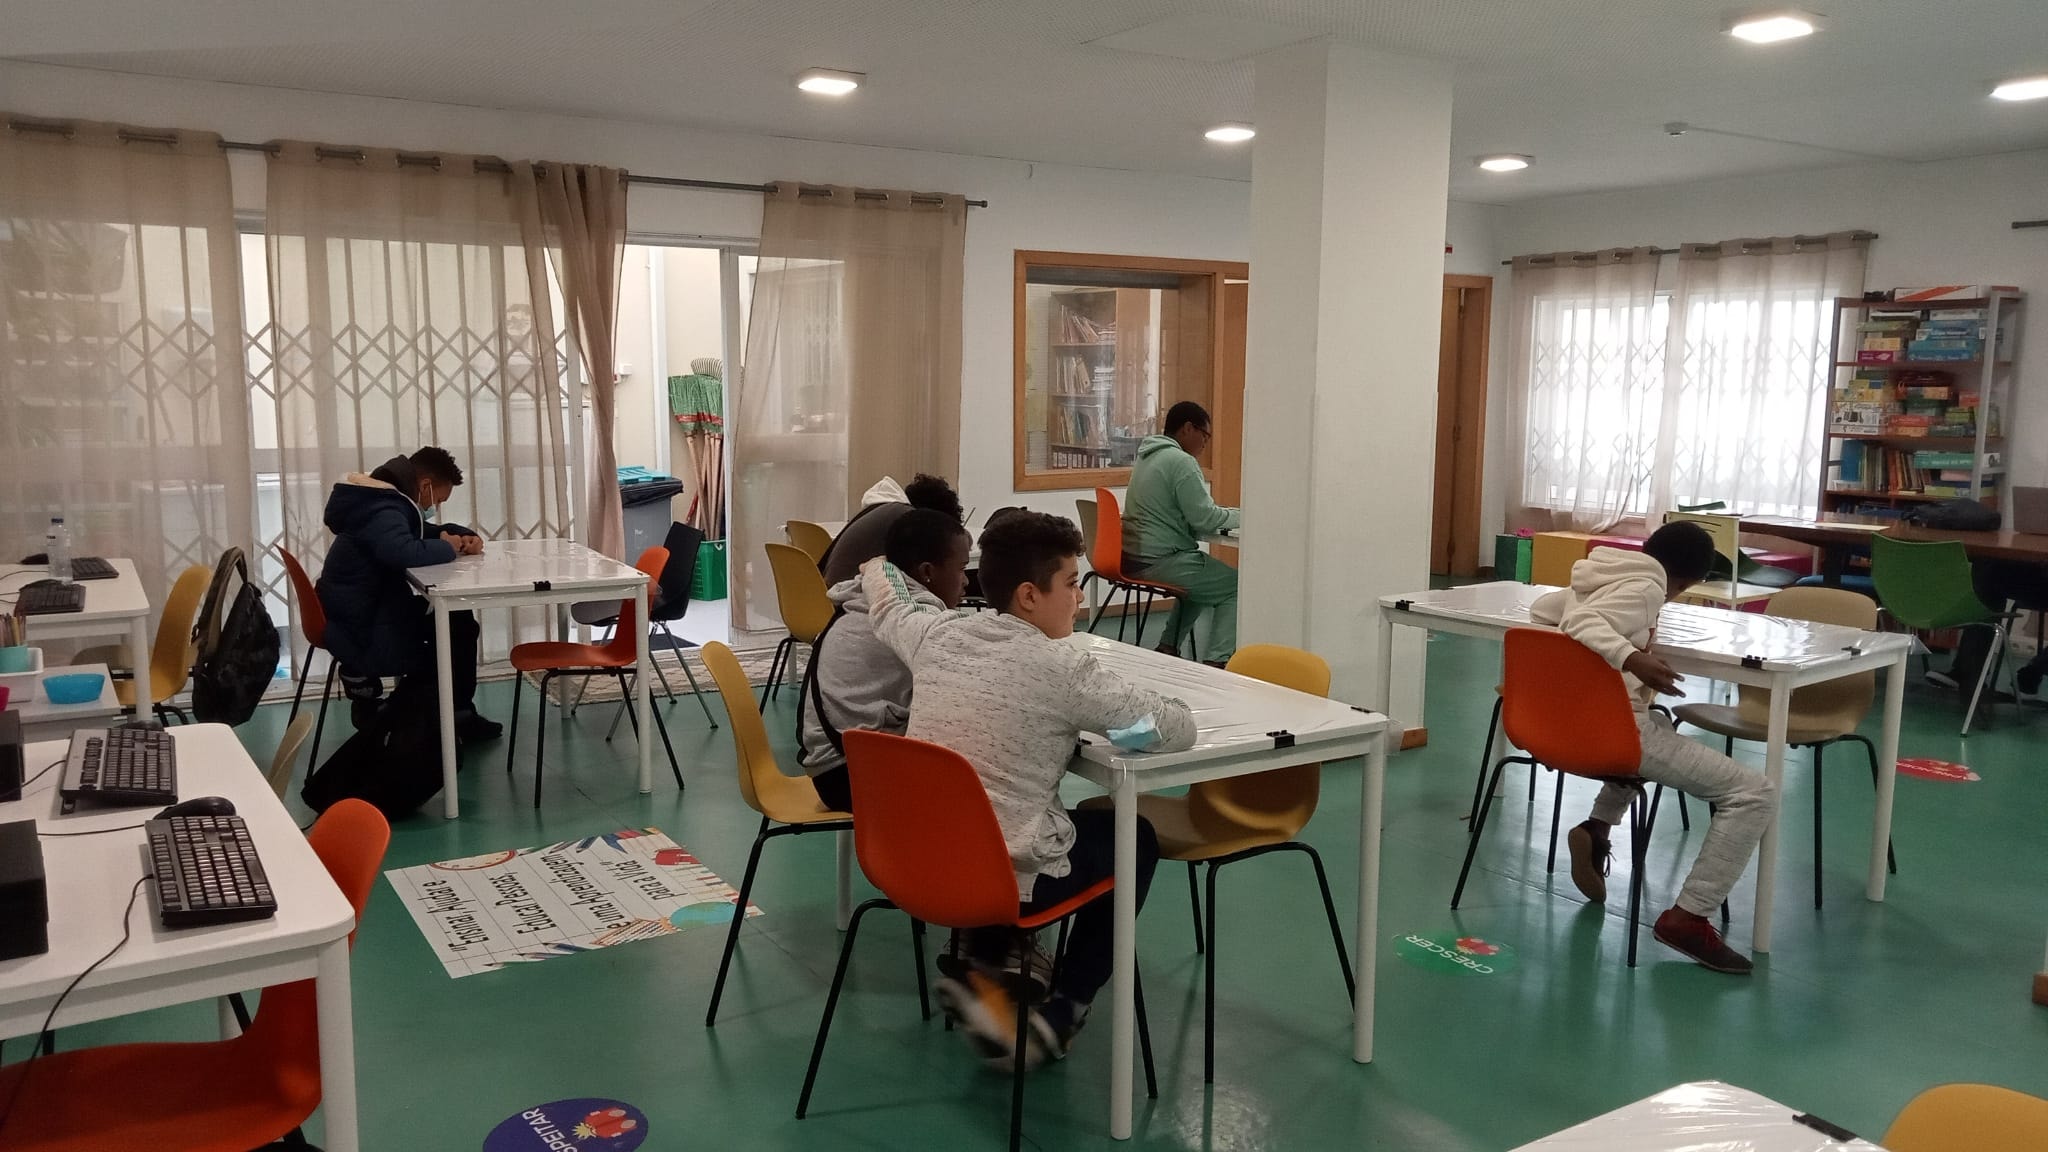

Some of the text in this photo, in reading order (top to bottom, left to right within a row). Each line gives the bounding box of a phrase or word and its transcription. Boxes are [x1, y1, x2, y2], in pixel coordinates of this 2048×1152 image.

[540, 853, 615, 906] Aprendizagem
[633, 875, 656, 883] a
[639, 881, 688, 900] para
[417, 886, 476, 914] Ajudar
[488, 871, 557, 934] Educar Pessoas,
[588, 902, 625, 923] uma
[1405, 935, 1494, 974] CRESCER
